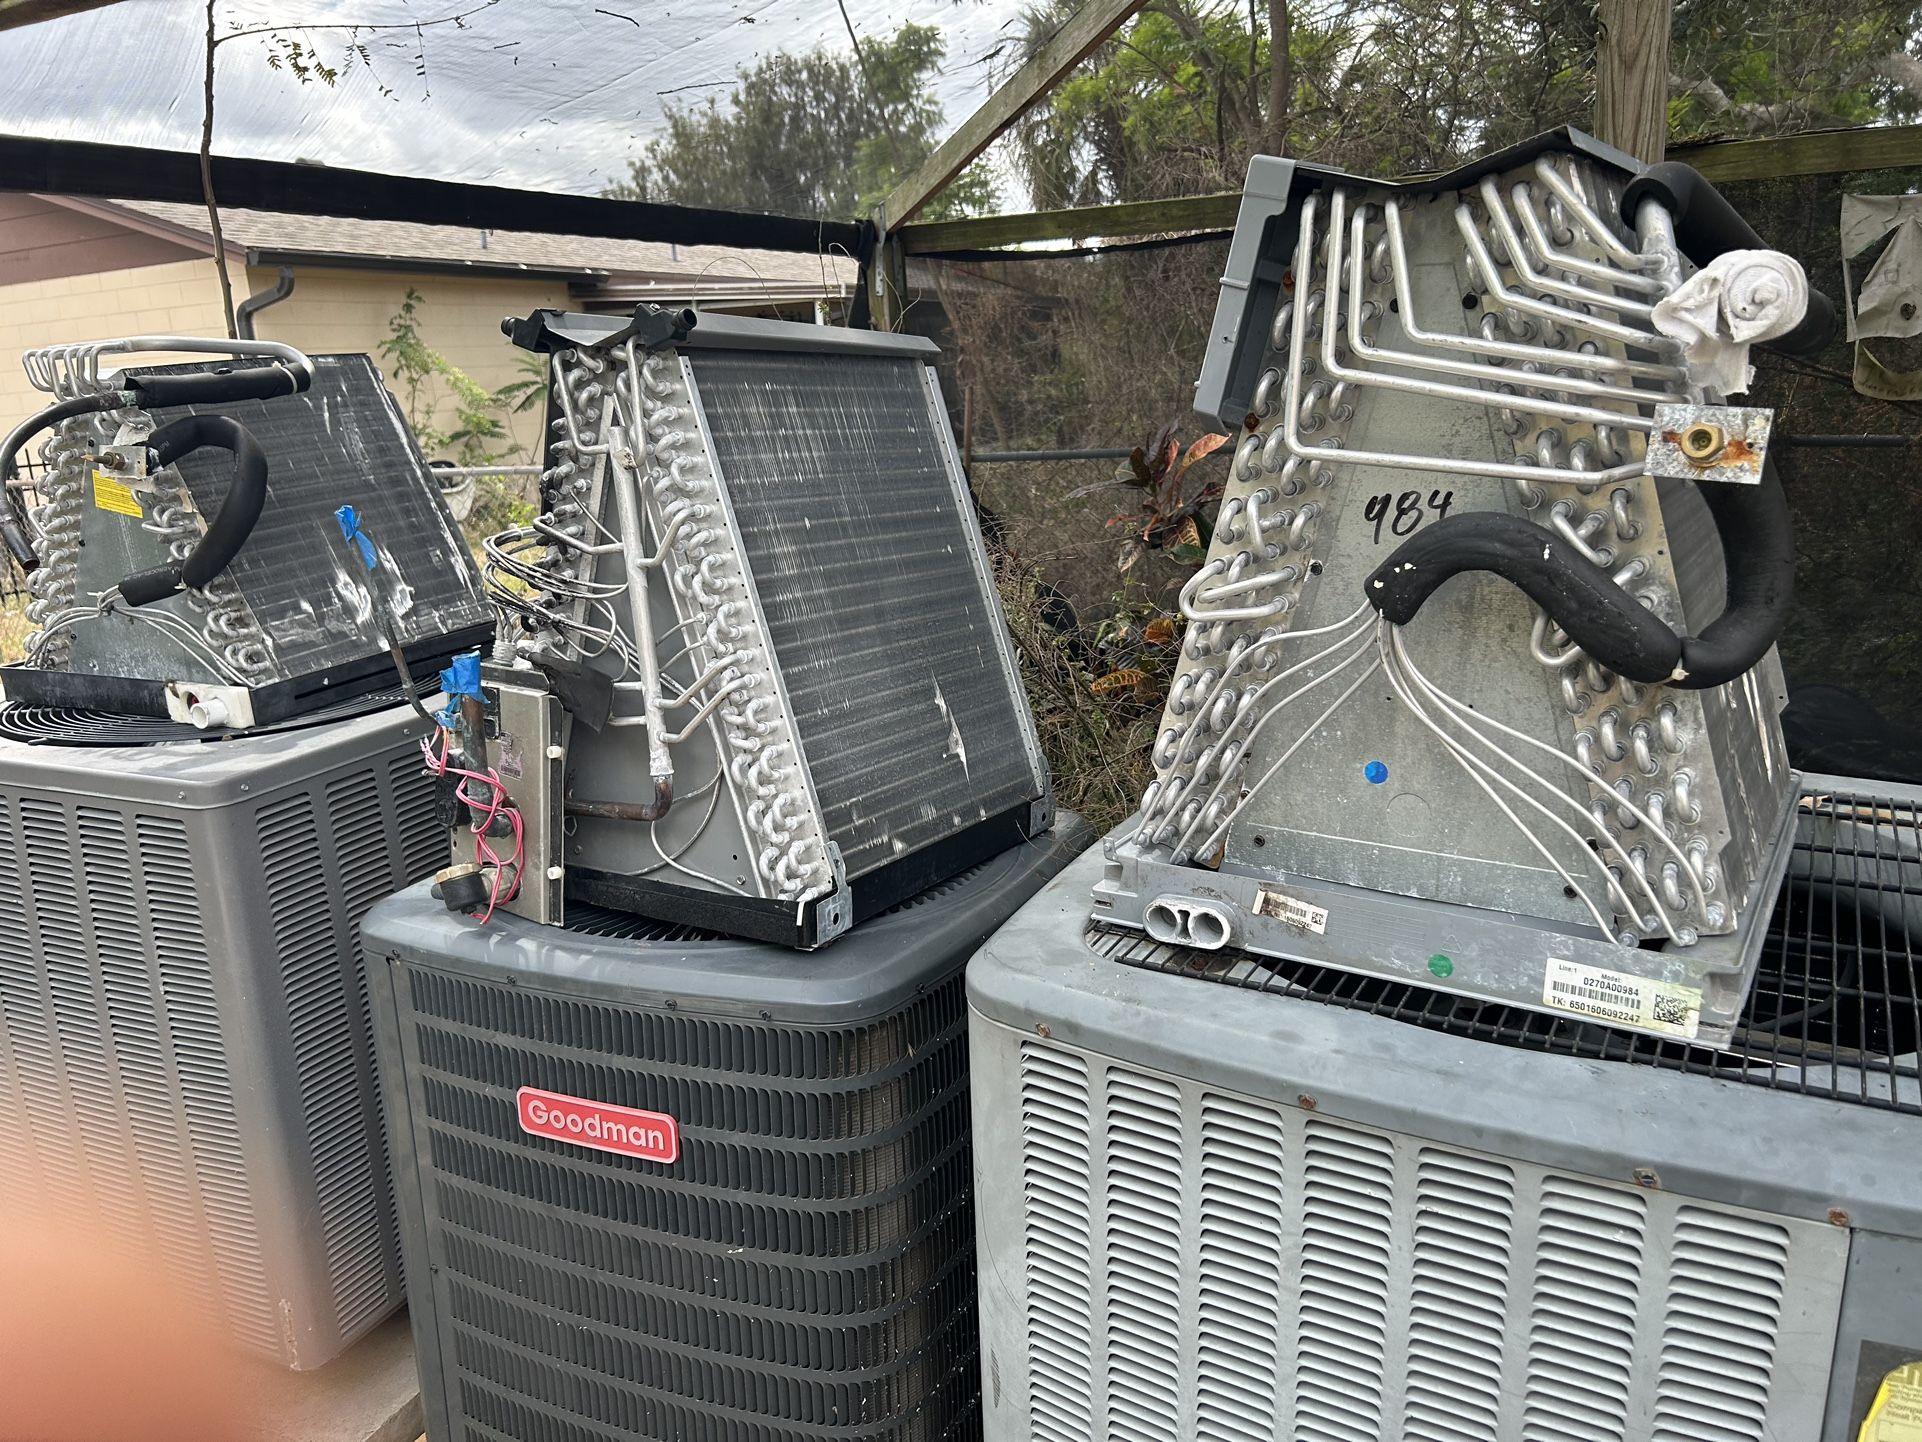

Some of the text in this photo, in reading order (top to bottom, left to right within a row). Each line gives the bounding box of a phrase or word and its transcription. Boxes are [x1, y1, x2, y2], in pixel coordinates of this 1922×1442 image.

[1364, 489, 1454, 545] 984
[1583, 977, 1639, 996] 0270A00984
[1601, 973, 1622, 983] Model:
[1552, 995, 1641, 1023] TK: 6501606092247
[527, 1099, 665, 1151] Goodman
